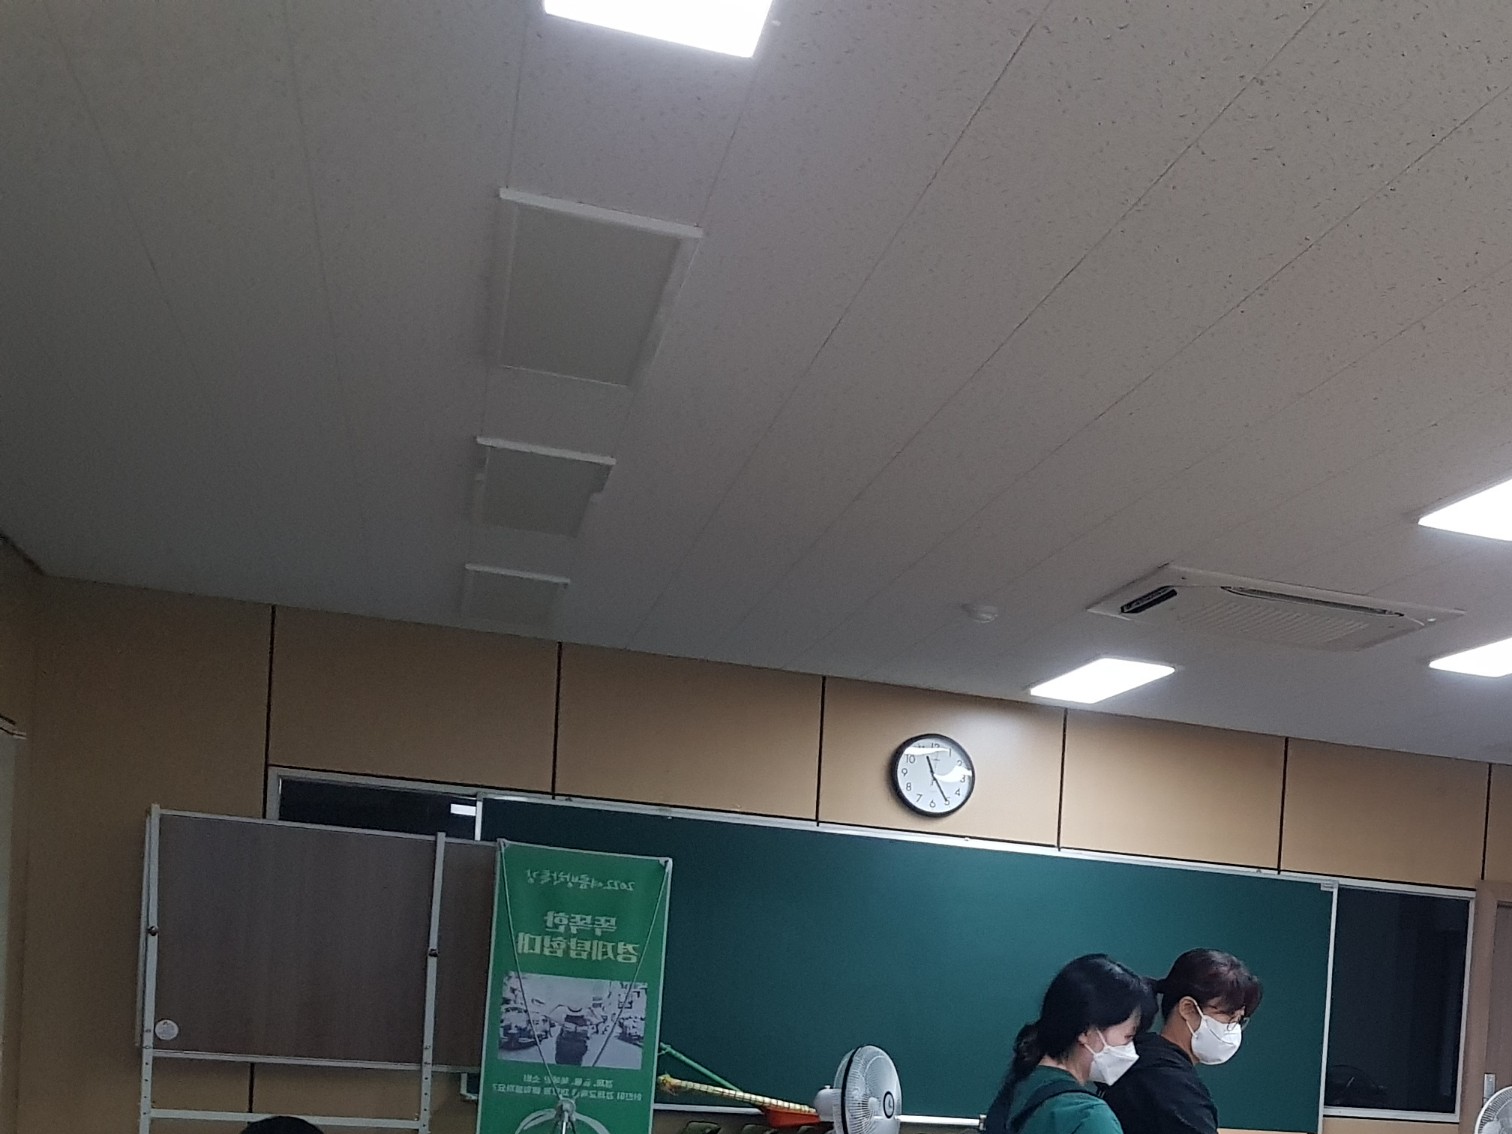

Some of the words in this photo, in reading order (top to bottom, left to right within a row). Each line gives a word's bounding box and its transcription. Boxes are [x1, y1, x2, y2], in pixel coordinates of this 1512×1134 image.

[906, 754, 916, 764] 10
[901, 768, 908, 777] 9
[960, 775, 966, 784] 3
[905, 782, 912, 792] 8
[955, 788, 962, 797] 4
[915, 794, 923, 804] 7
[929, 799, 936, 809] 6
